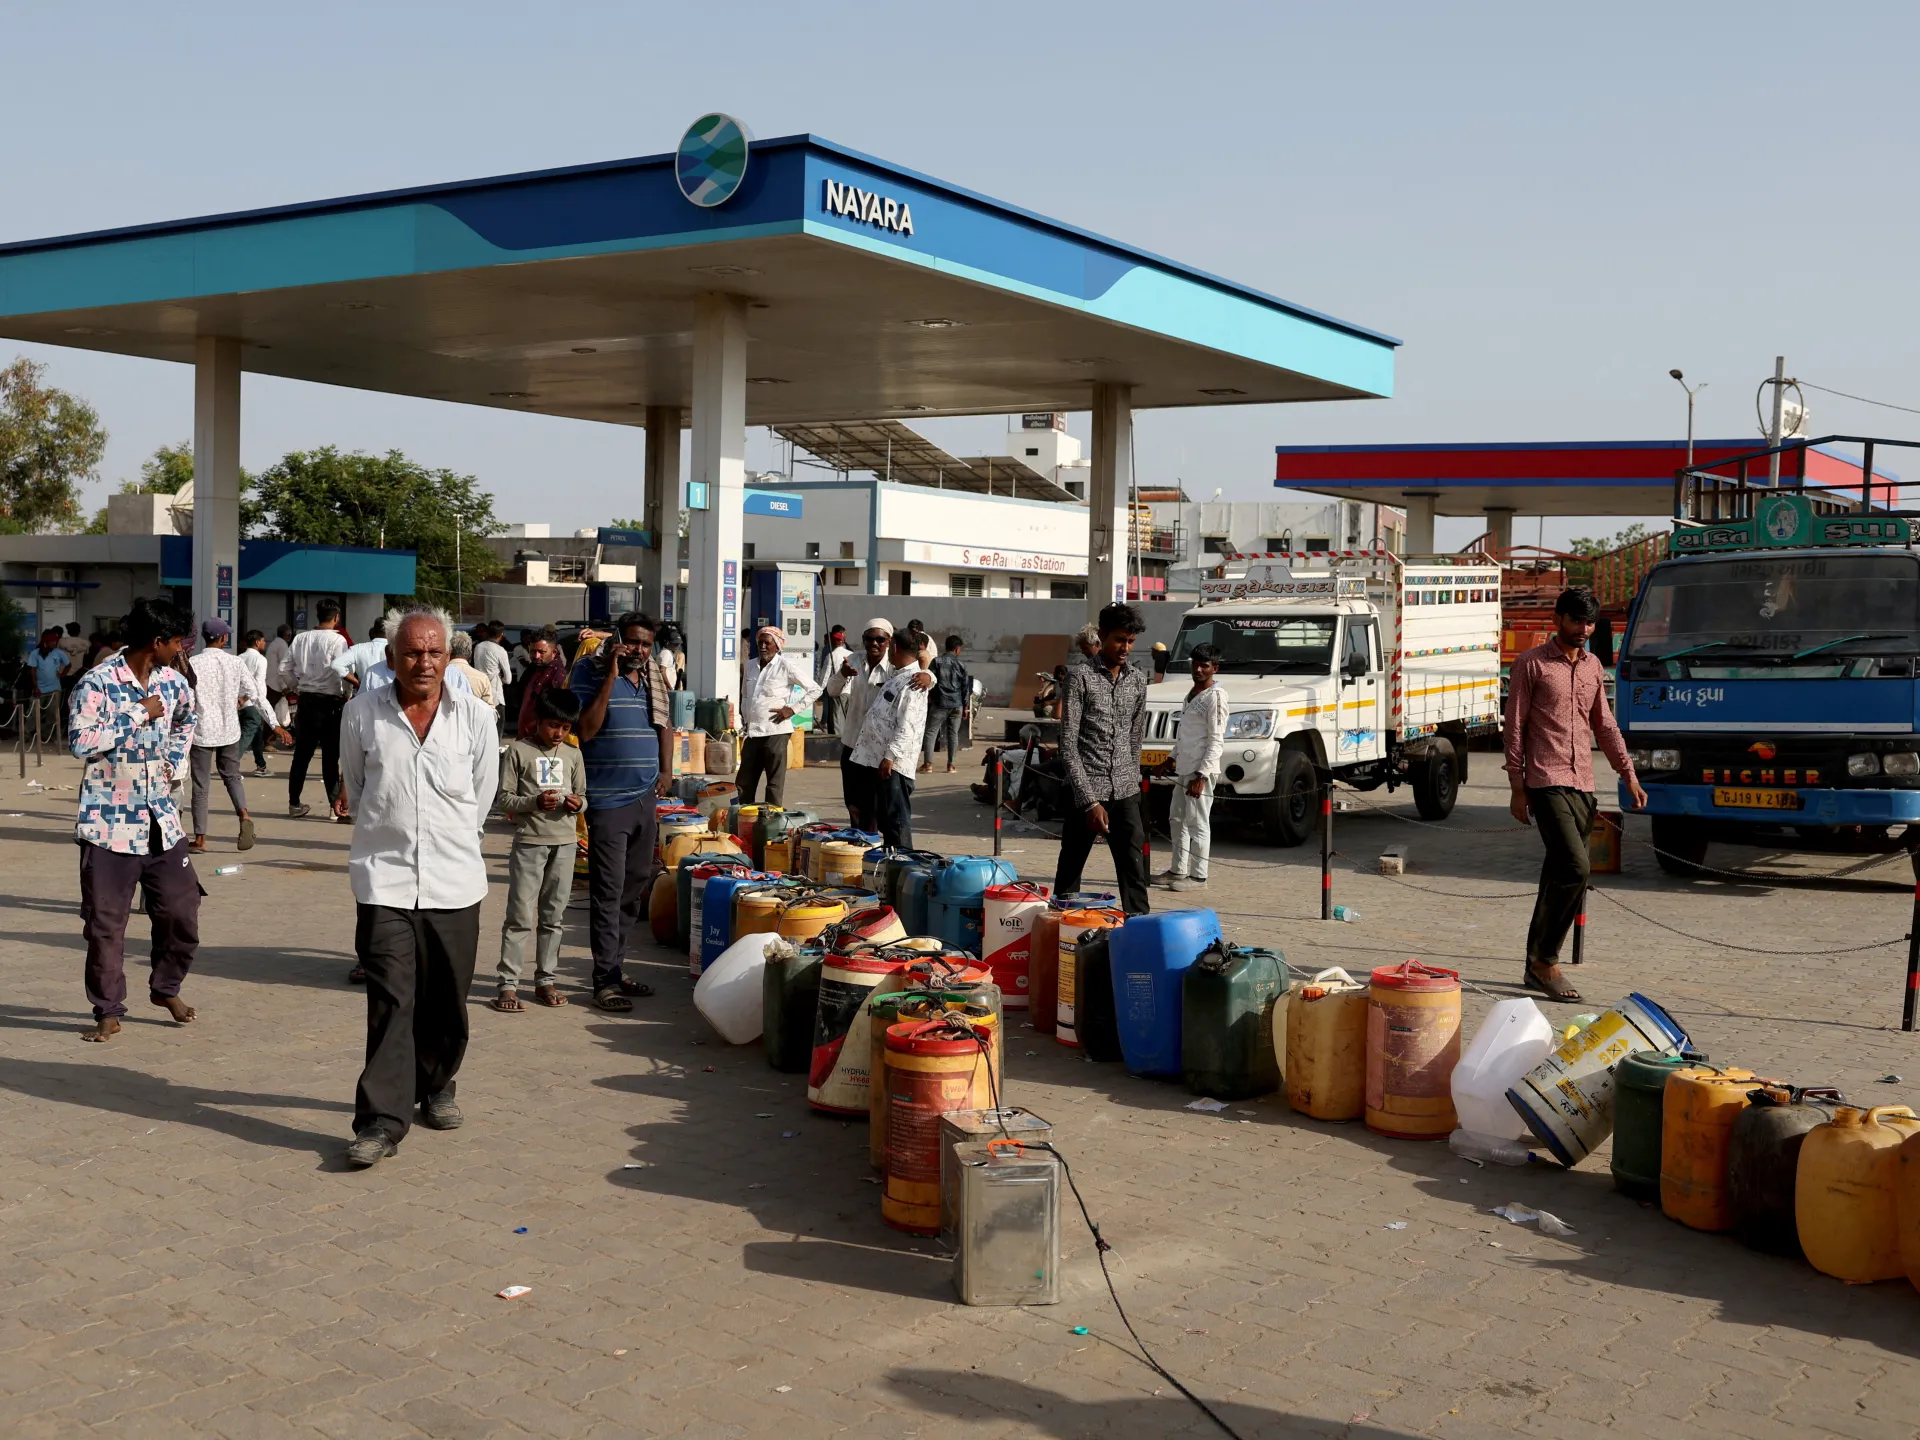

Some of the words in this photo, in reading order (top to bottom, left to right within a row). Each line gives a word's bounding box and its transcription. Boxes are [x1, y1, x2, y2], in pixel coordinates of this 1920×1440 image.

[824, 178, 914, 236] NAYARA
[695, 487, 701, 504] 1
[769, 501, 789, 511] DIESEL
[610, 534, 627, 542] PETROL
[1033, 555, 1066, 572] Station
[1201, 583, 1232, 594] જય
[1296, 583, 1336, 593] દાદા
[540, 759, 560, 784] K
[1702, 769, 1820, 784] EICHER
[999, 917, 1021, 927] Volt
[709, 925, 721, 937] Jay
